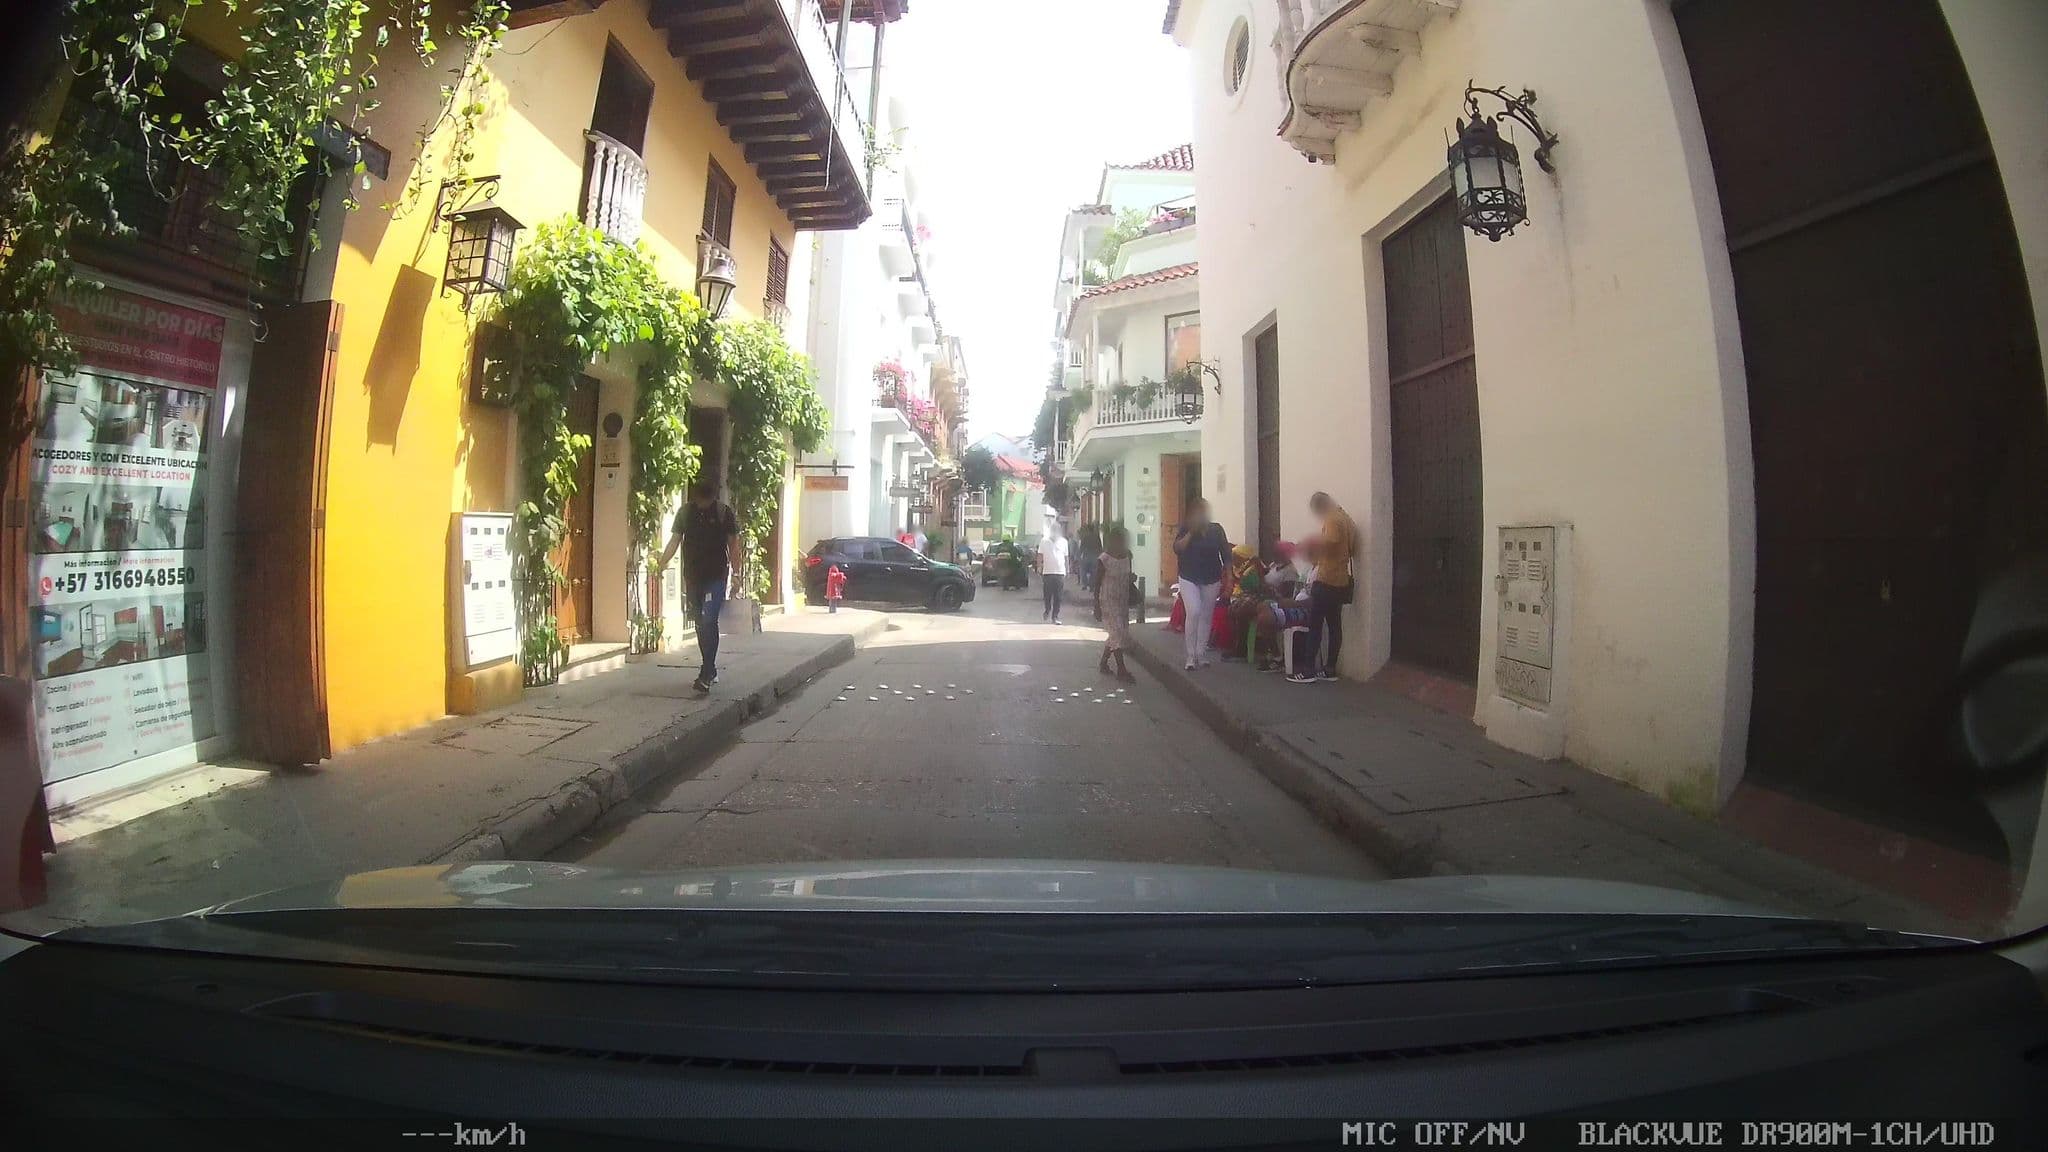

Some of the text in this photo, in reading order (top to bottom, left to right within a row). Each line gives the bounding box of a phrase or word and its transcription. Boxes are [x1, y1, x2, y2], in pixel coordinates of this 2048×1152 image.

[145, 306, 180, 332] POR
[145, 349, 178, 364] CENTRO
[32, 449, 91, 462] ACOGEDORES
[93, 451, 99, 461] Y
[101, 451, 119, 464] CON
[121, 454, 165, 467] EXCELENTE
[52, 464, 191, 481] COZY AND EXCELLENT LOCATION
[55, 567, 195, 593] +57 3166948550
